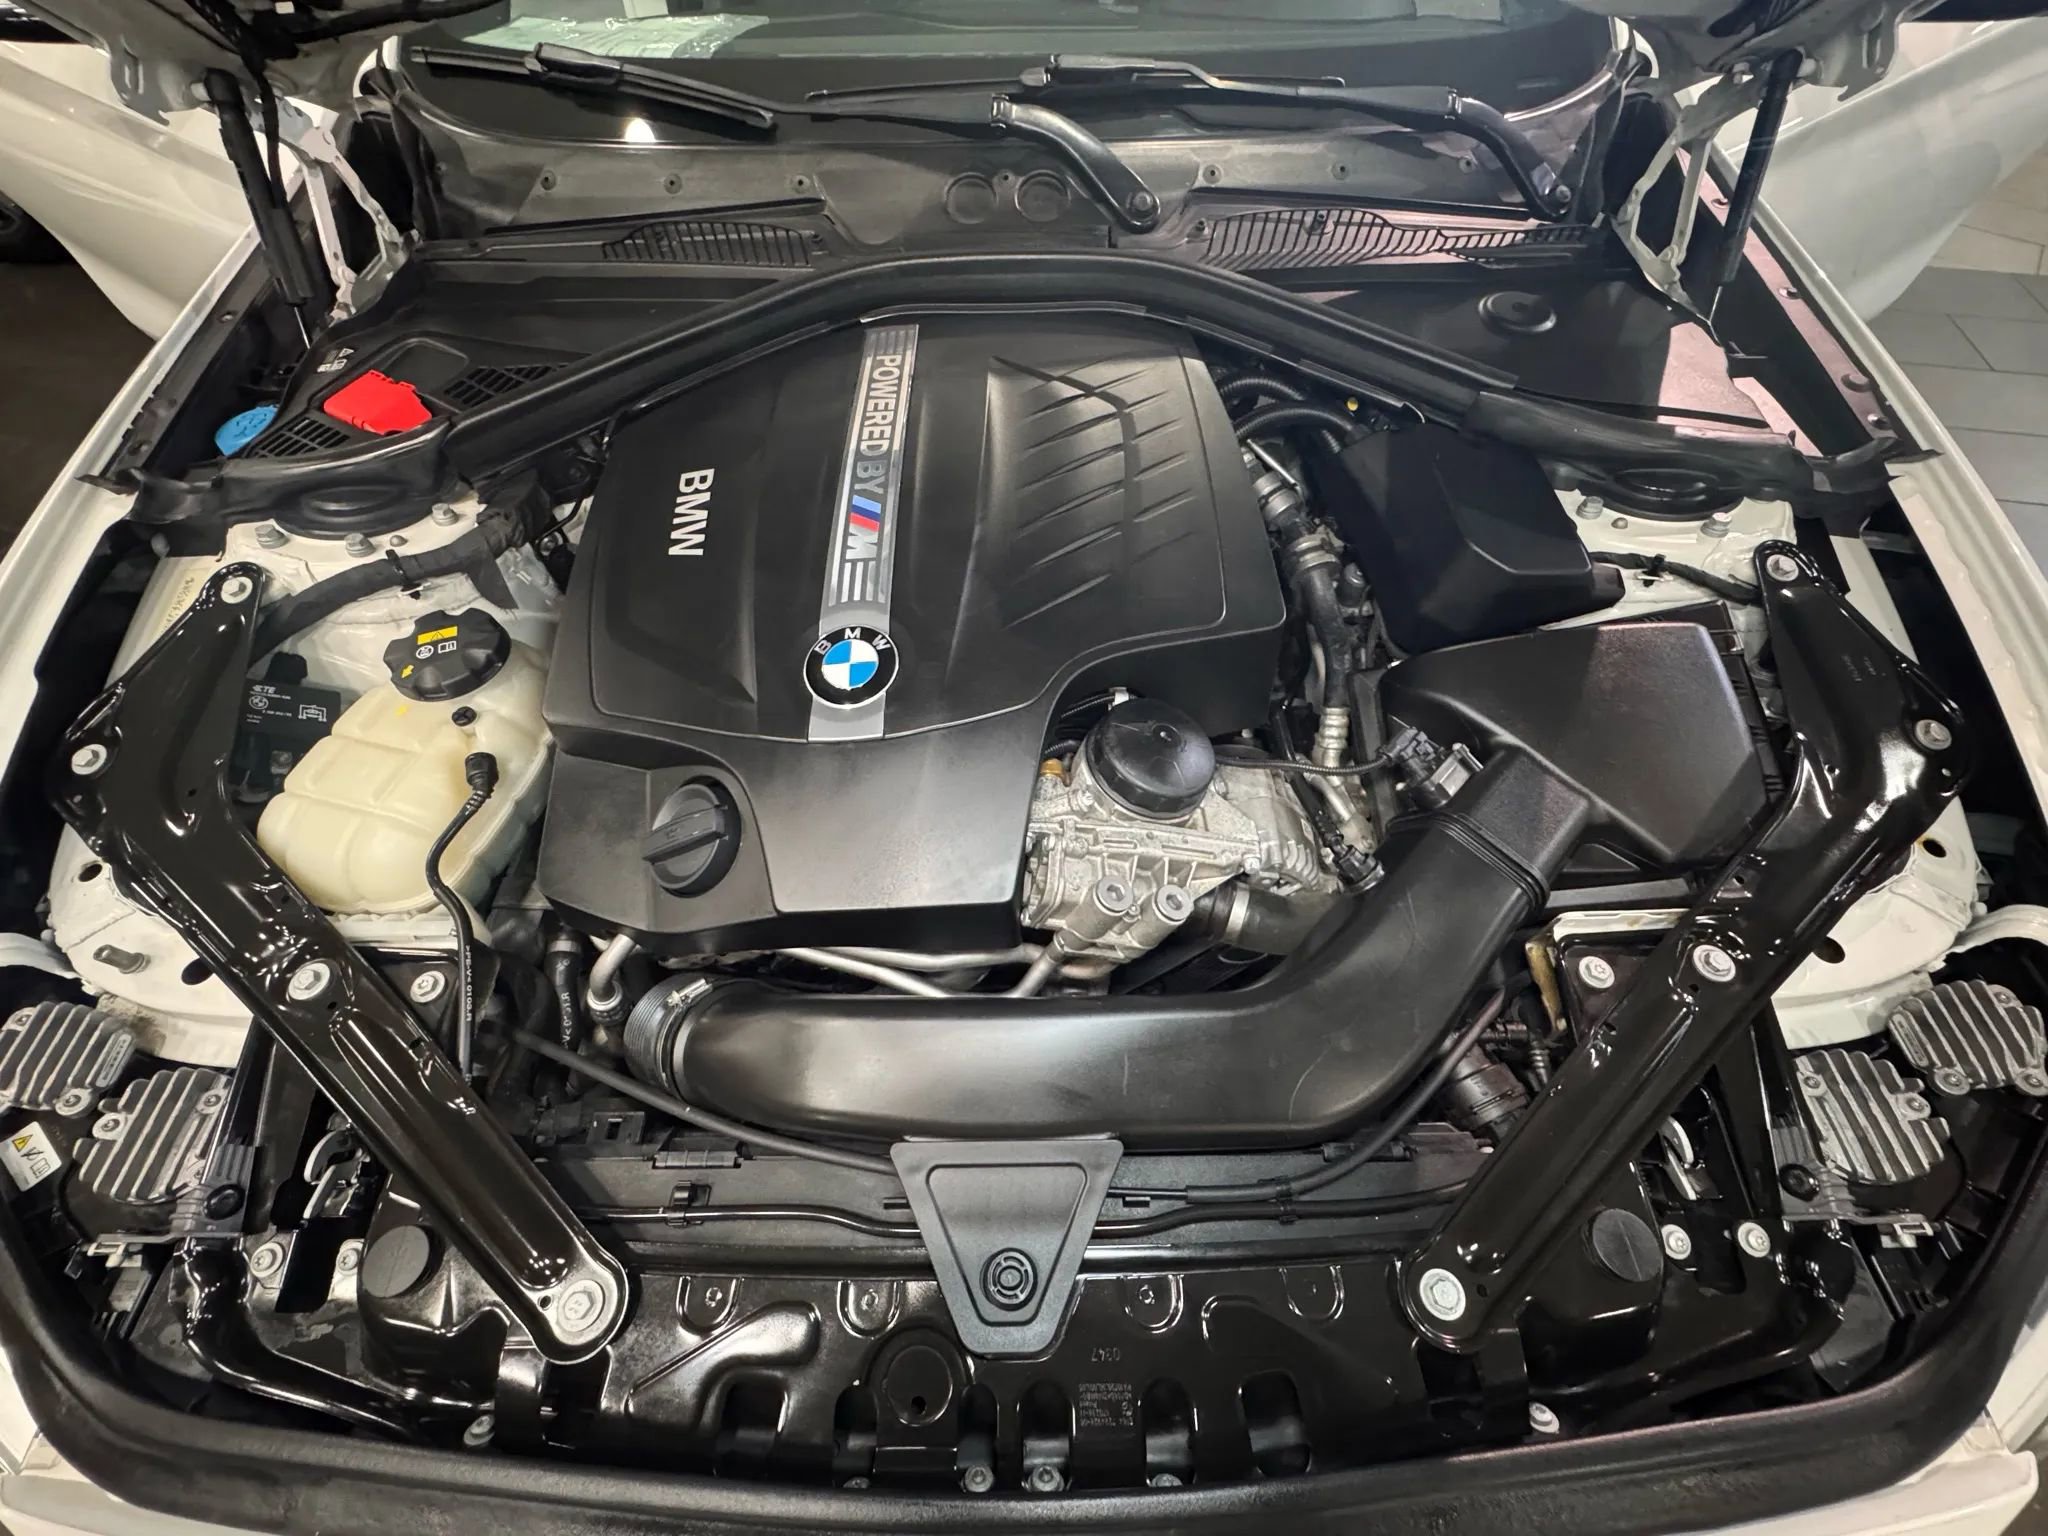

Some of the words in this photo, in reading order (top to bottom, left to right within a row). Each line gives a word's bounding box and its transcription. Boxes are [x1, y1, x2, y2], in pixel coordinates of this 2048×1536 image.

[860, 355, 902, 456] POWERED
[854, 460, 888, 494] BY
[668, 468, 715, 556] BMW
[814, 627, 891, 655] BMW
